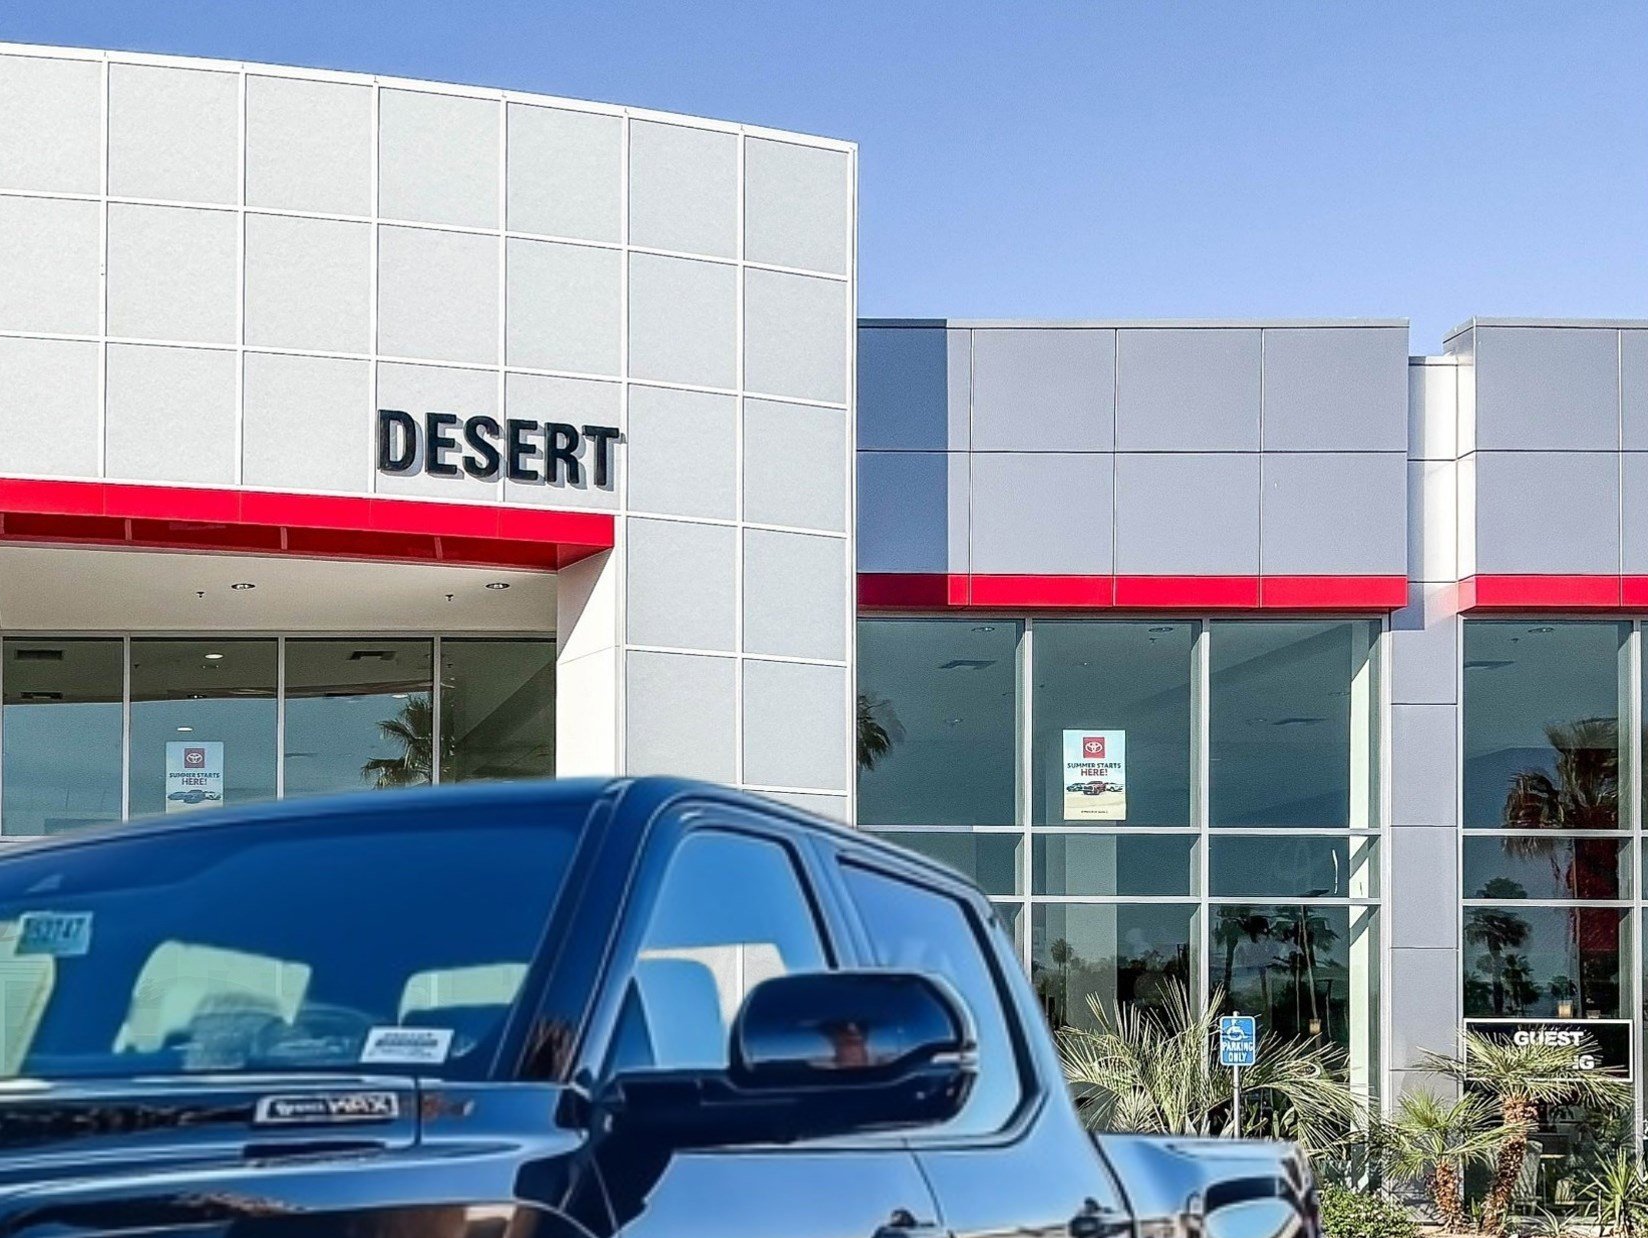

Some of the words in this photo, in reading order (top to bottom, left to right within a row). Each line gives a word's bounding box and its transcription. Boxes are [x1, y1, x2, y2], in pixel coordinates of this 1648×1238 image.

[377, 409, 620, 486] DESERT
[1080, 768, 1108, 777] HERE!
[181, 777, 208, 786] HERE!
[1513, 1031, 1585, 1046] GUEST
[1221, 1041, 1254, 1052] PARKING
[1228, 1052, 1248, 1063] ONLY
